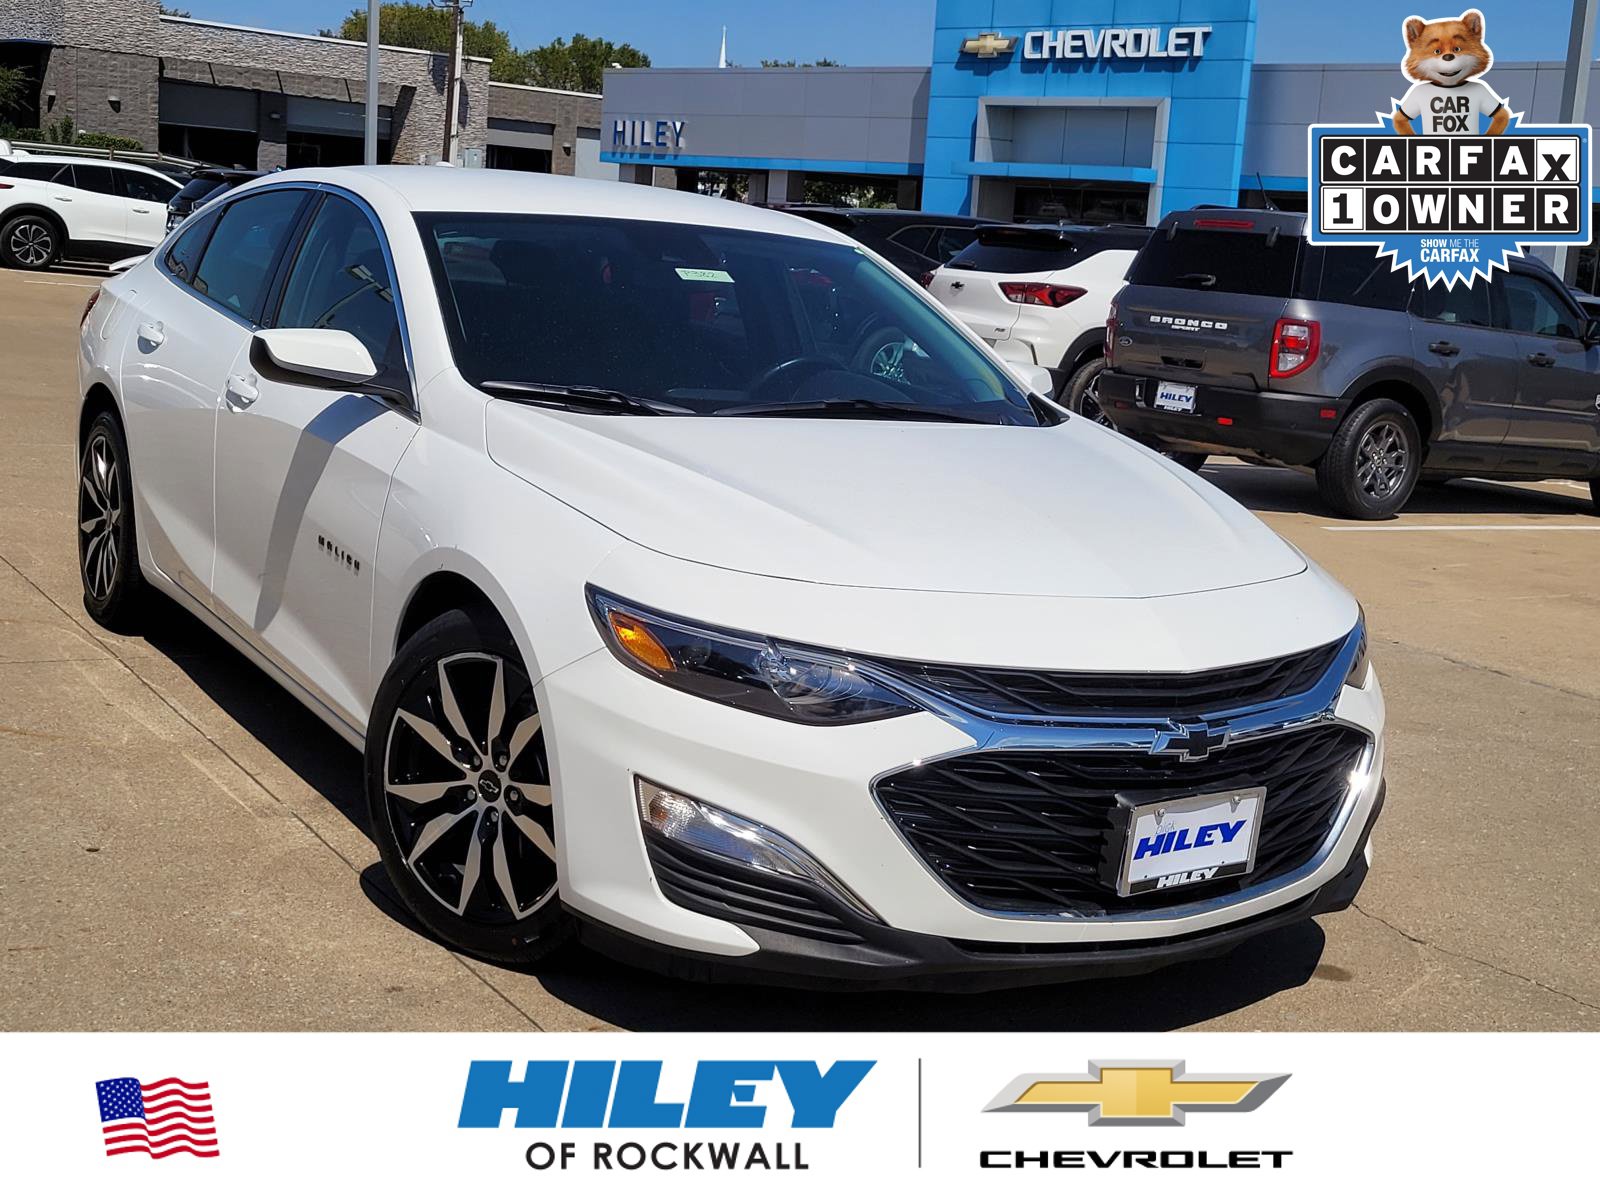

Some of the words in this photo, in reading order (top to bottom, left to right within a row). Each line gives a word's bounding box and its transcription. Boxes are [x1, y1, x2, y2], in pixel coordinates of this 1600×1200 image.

[1024, 26, 1212, 59] CHEVROLET
[613, 120, 685, 147] HILEY
[1150, 315, 1228, 330] BRONCO
[1171, 324, 1201, 332] SPORT
[1160, 391, 1193, 403] HILEY
[318, 534, 360, 571] MALIBU
[1133, 819, 1248, 860] HILEY
[1156, 866, 1219, 889] HILEY
